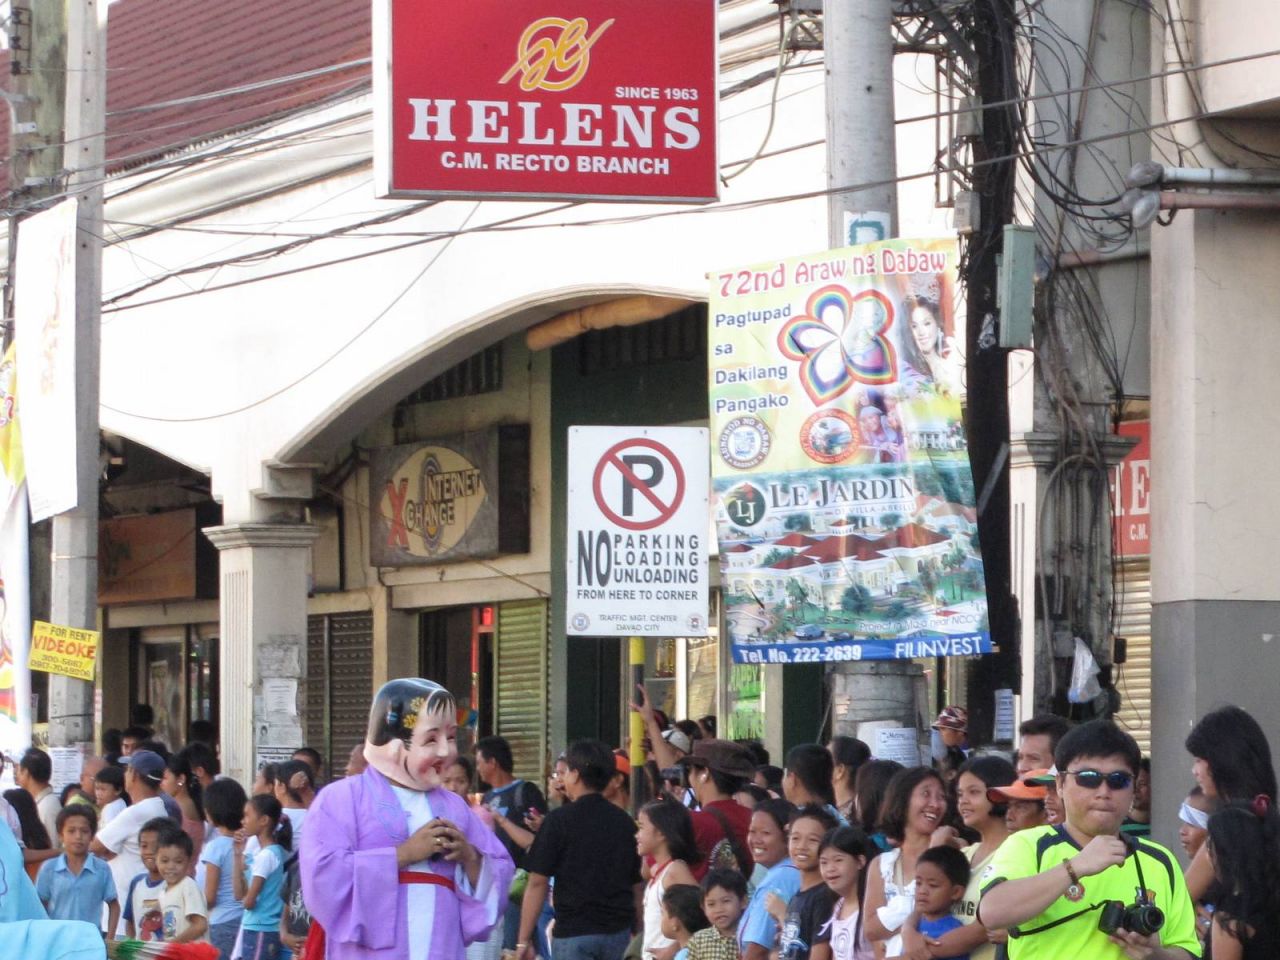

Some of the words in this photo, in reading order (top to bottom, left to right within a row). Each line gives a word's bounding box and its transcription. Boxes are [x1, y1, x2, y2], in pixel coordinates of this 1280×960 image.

[615, 86, 660, 100] SINCE
[664, 87, 698, 101] 1963
[408, 98, 701, 149] HELENS
[440, 151, 489, 170] C.M.
[495, 153, 570, 172] RECTO
[576, 155, 669, 175] BRANCH
[718, 263, 786, 298] 72nd
[795, 259, 847, 285] Araw
[853, 252, 876, 275] ng
[882, 248, 946, 274] Dabaw
[715, 303, 792, 328] Pagtupad
[715, 343, 733, 356] sa
[715, 364, 788, 385] Dakilang
[715, 393, 789, 414] Pangako
[424, 469, 480, 501] INTERNET
[770, 484, 808, 508] LE
[816, 477, 914, 507] JARDIN
[614, 534, 699, 549] PARKING
[577, 530, 612, 588] NO
[614, 551, 699, 566] LOADING
[614, 568, 699, 584] UNLOADING
[577, 589, 606, 600] FROM
[609, 590, 636, 600] HERE
[640, 590, 653, 600] TO
[656, 590, 698, 601] CORNER
[599, 614, 627, 622] TRAFFIC
[650, 614, 678, 622] CENTER
[616, 623, 642, 631] DAVAO
[645, 623, 660, 631] CITY
[50, 626, 67, 639] FOR
[69, 630, 93, 642] RENT
[33, 635, 97, 659] VIDEOKE
[739, 649, 766, 663] Tel.
[768, 648, 791, 663] No.
[792, 645, 862, 663] 222-2639
[895, 636, 983, 659] FILINVEST
